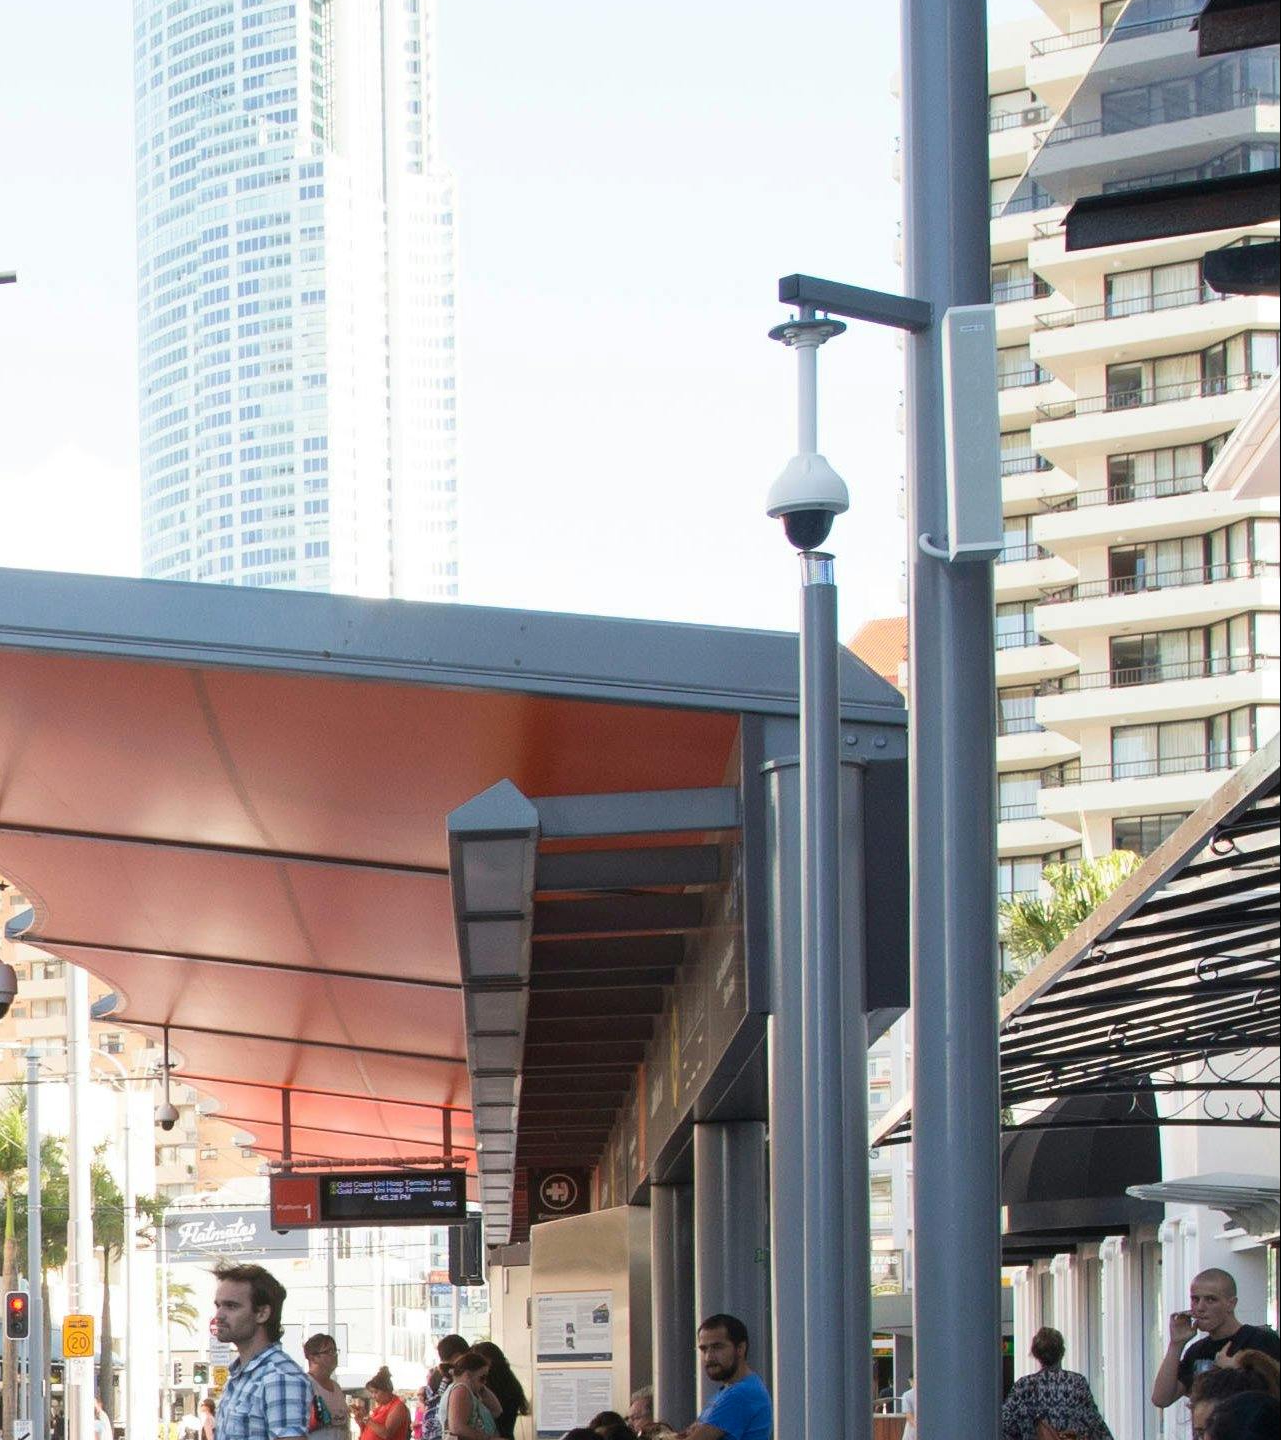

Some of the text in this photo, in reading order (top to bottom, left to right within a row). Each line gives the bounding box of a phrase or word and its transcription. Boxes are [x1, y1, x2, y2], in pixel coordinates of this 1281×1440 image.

[303, 1203, 312, 1219] 1
[178, 1217, 257, 1248] Flatmates
[71, 1336, 87, 1350] 20
